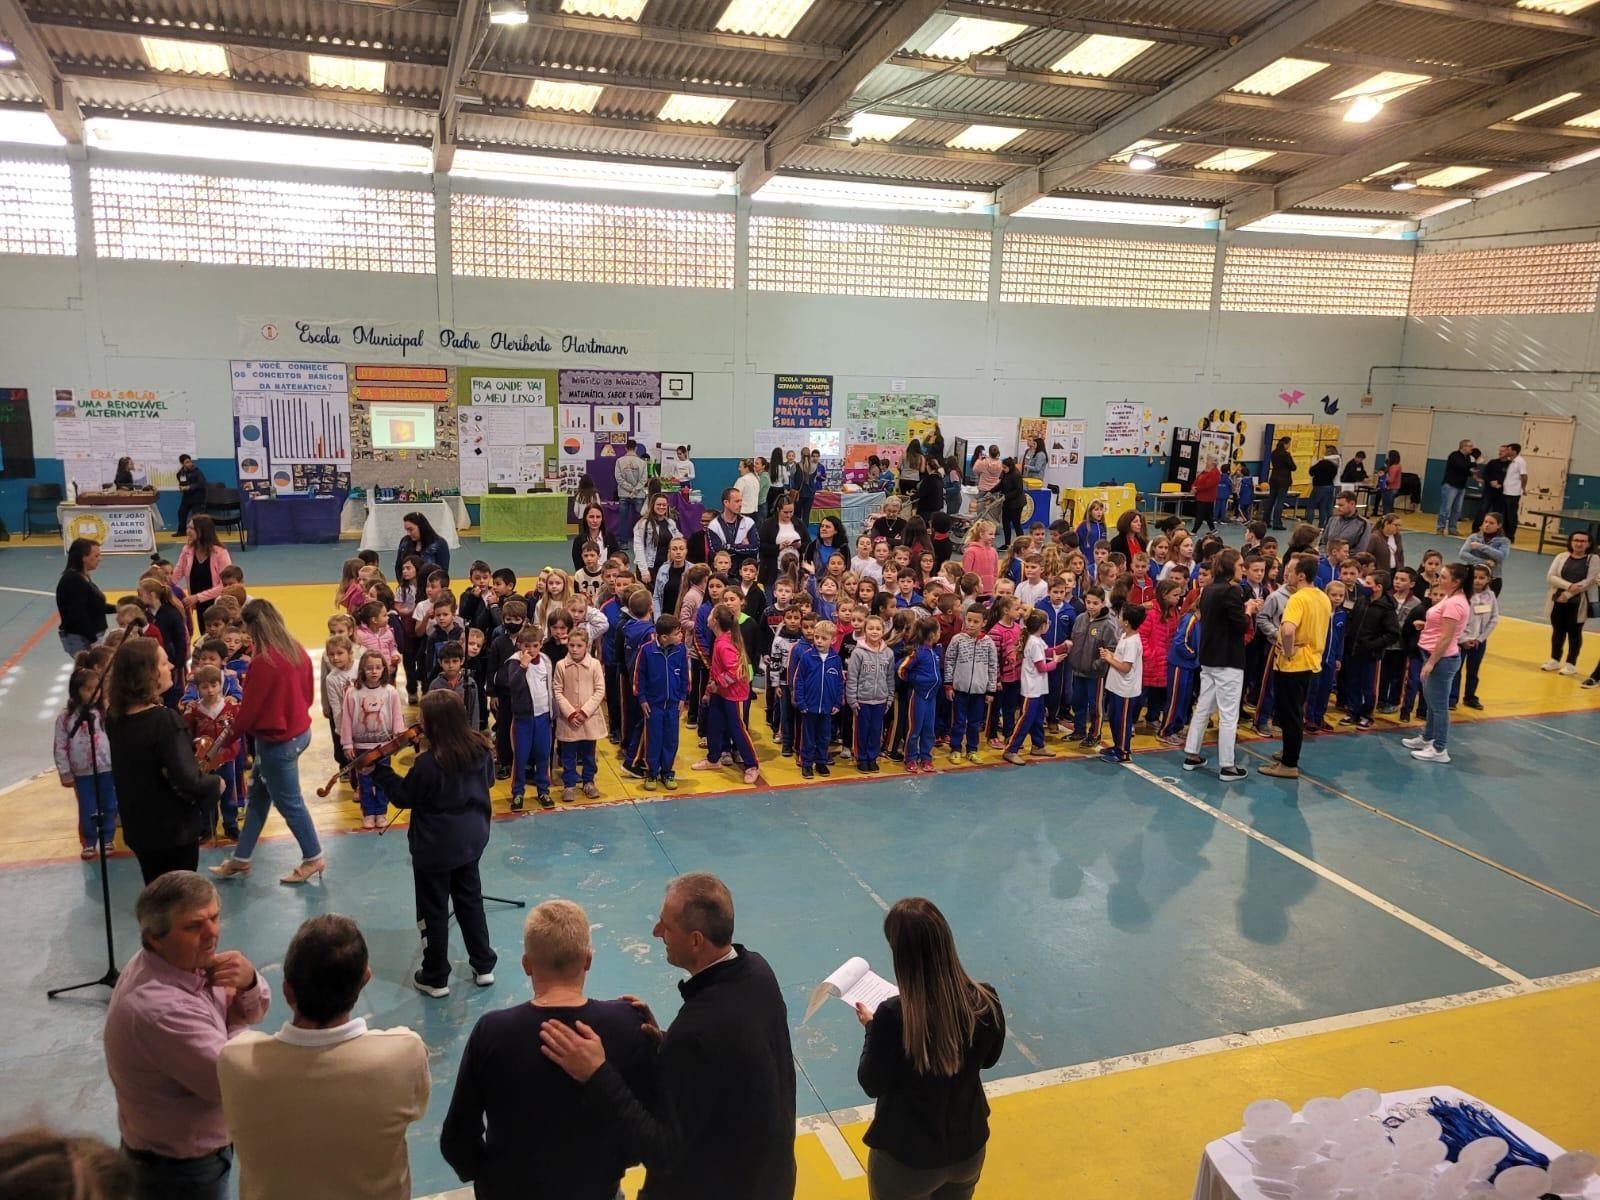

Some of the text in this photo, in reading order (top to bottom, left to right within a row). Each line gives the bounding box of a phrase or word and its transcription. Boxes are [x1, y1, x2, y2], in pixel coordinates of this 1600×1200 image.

[295, 321, 629, 357] Escola Municipal Padre Heriberto Hartmann
[288, 363, 329, 371] CONHECE
[252, 371, 302, 379] CONCEITOS
[472, 380, 542, 391] PRA ONDE VAI
[473, 393, 481, 403] O
[485, 393, 506, 403] MEU
[607, 391, 626, 399] SABOR
[77, 399, 169, 410] UMA RENOVÁVEL
[817, 398, 829, 407] NA
[85, 409, 160, 418] ALTERNATIVA
[817, 408, 830, 416] DO
[780, 417, 824, 427] DIA A DIA
